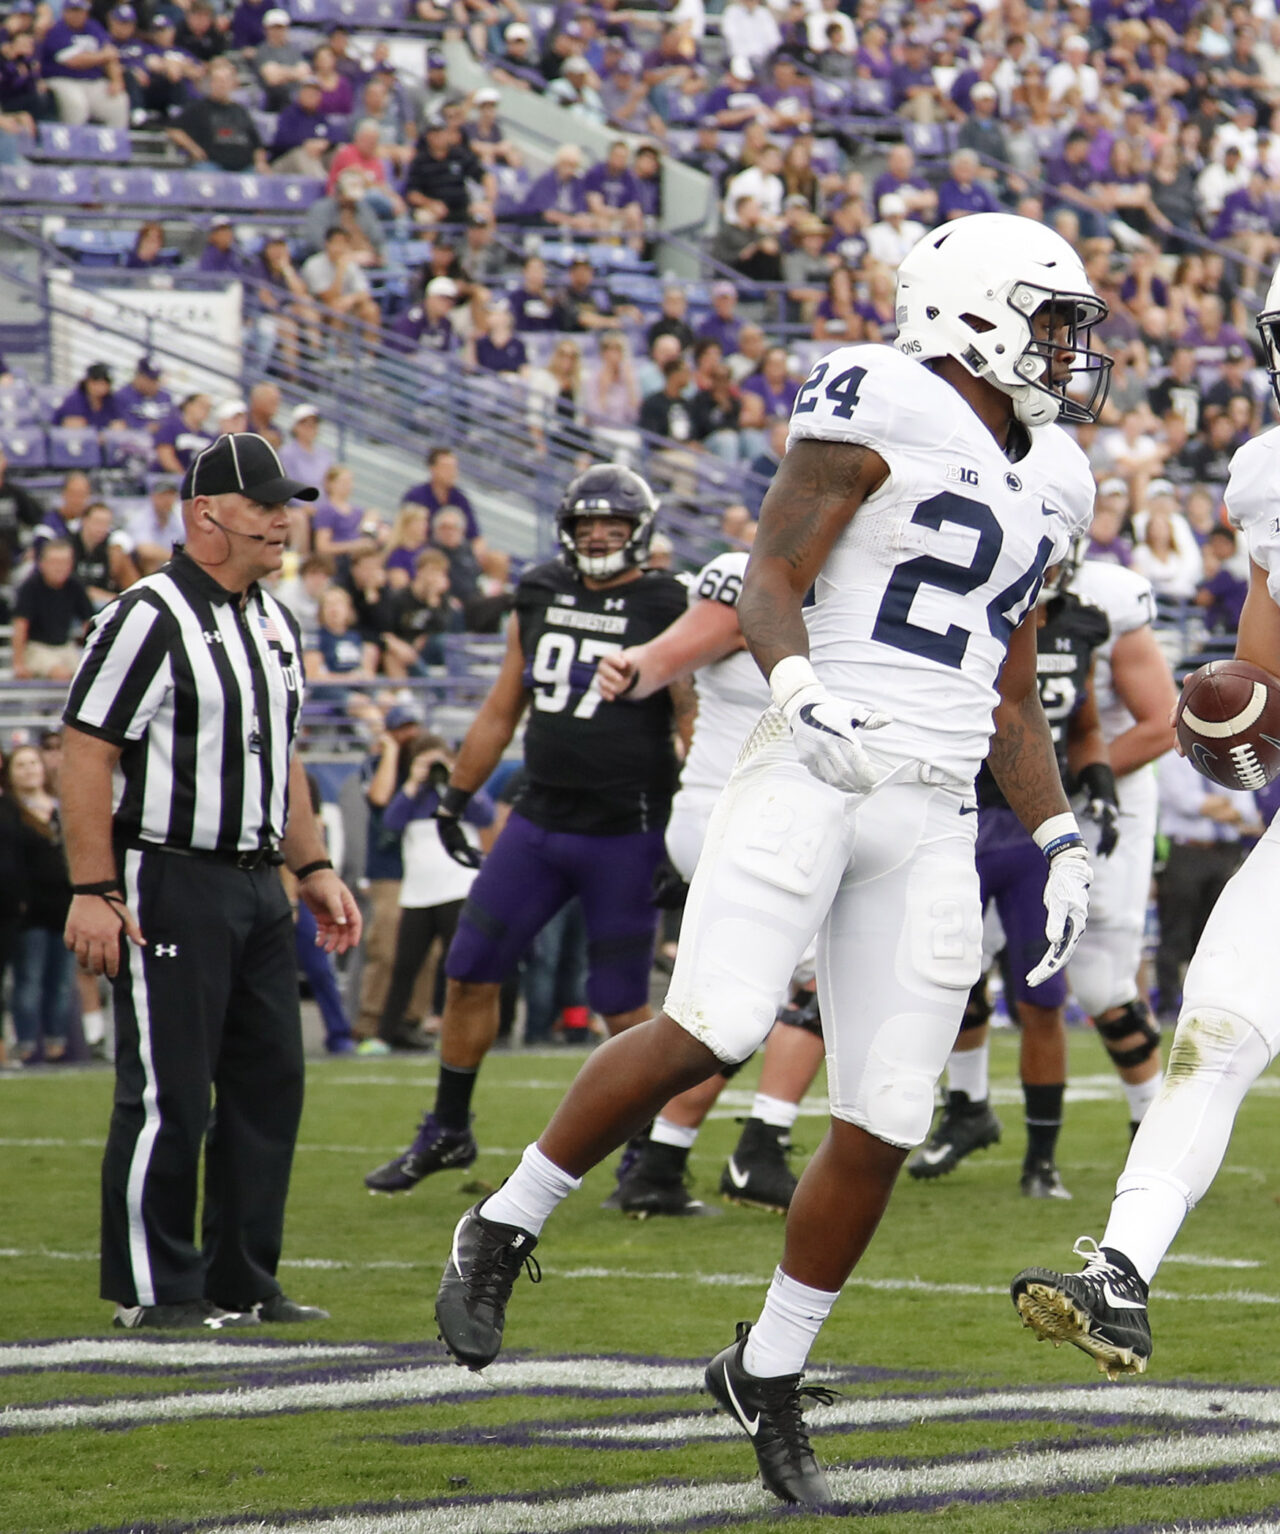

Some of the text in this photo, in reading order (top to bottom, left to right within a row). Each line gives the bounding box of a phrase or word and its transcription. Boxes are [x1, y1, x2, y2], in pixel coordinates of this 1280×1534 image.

[793, 362, 869, 421] 24
[699, 569, 743, 606] 66
[871, 490, 1055, 670] 24
[281, 665, 297, 692] U
[531, 632, 623, 720] 97
